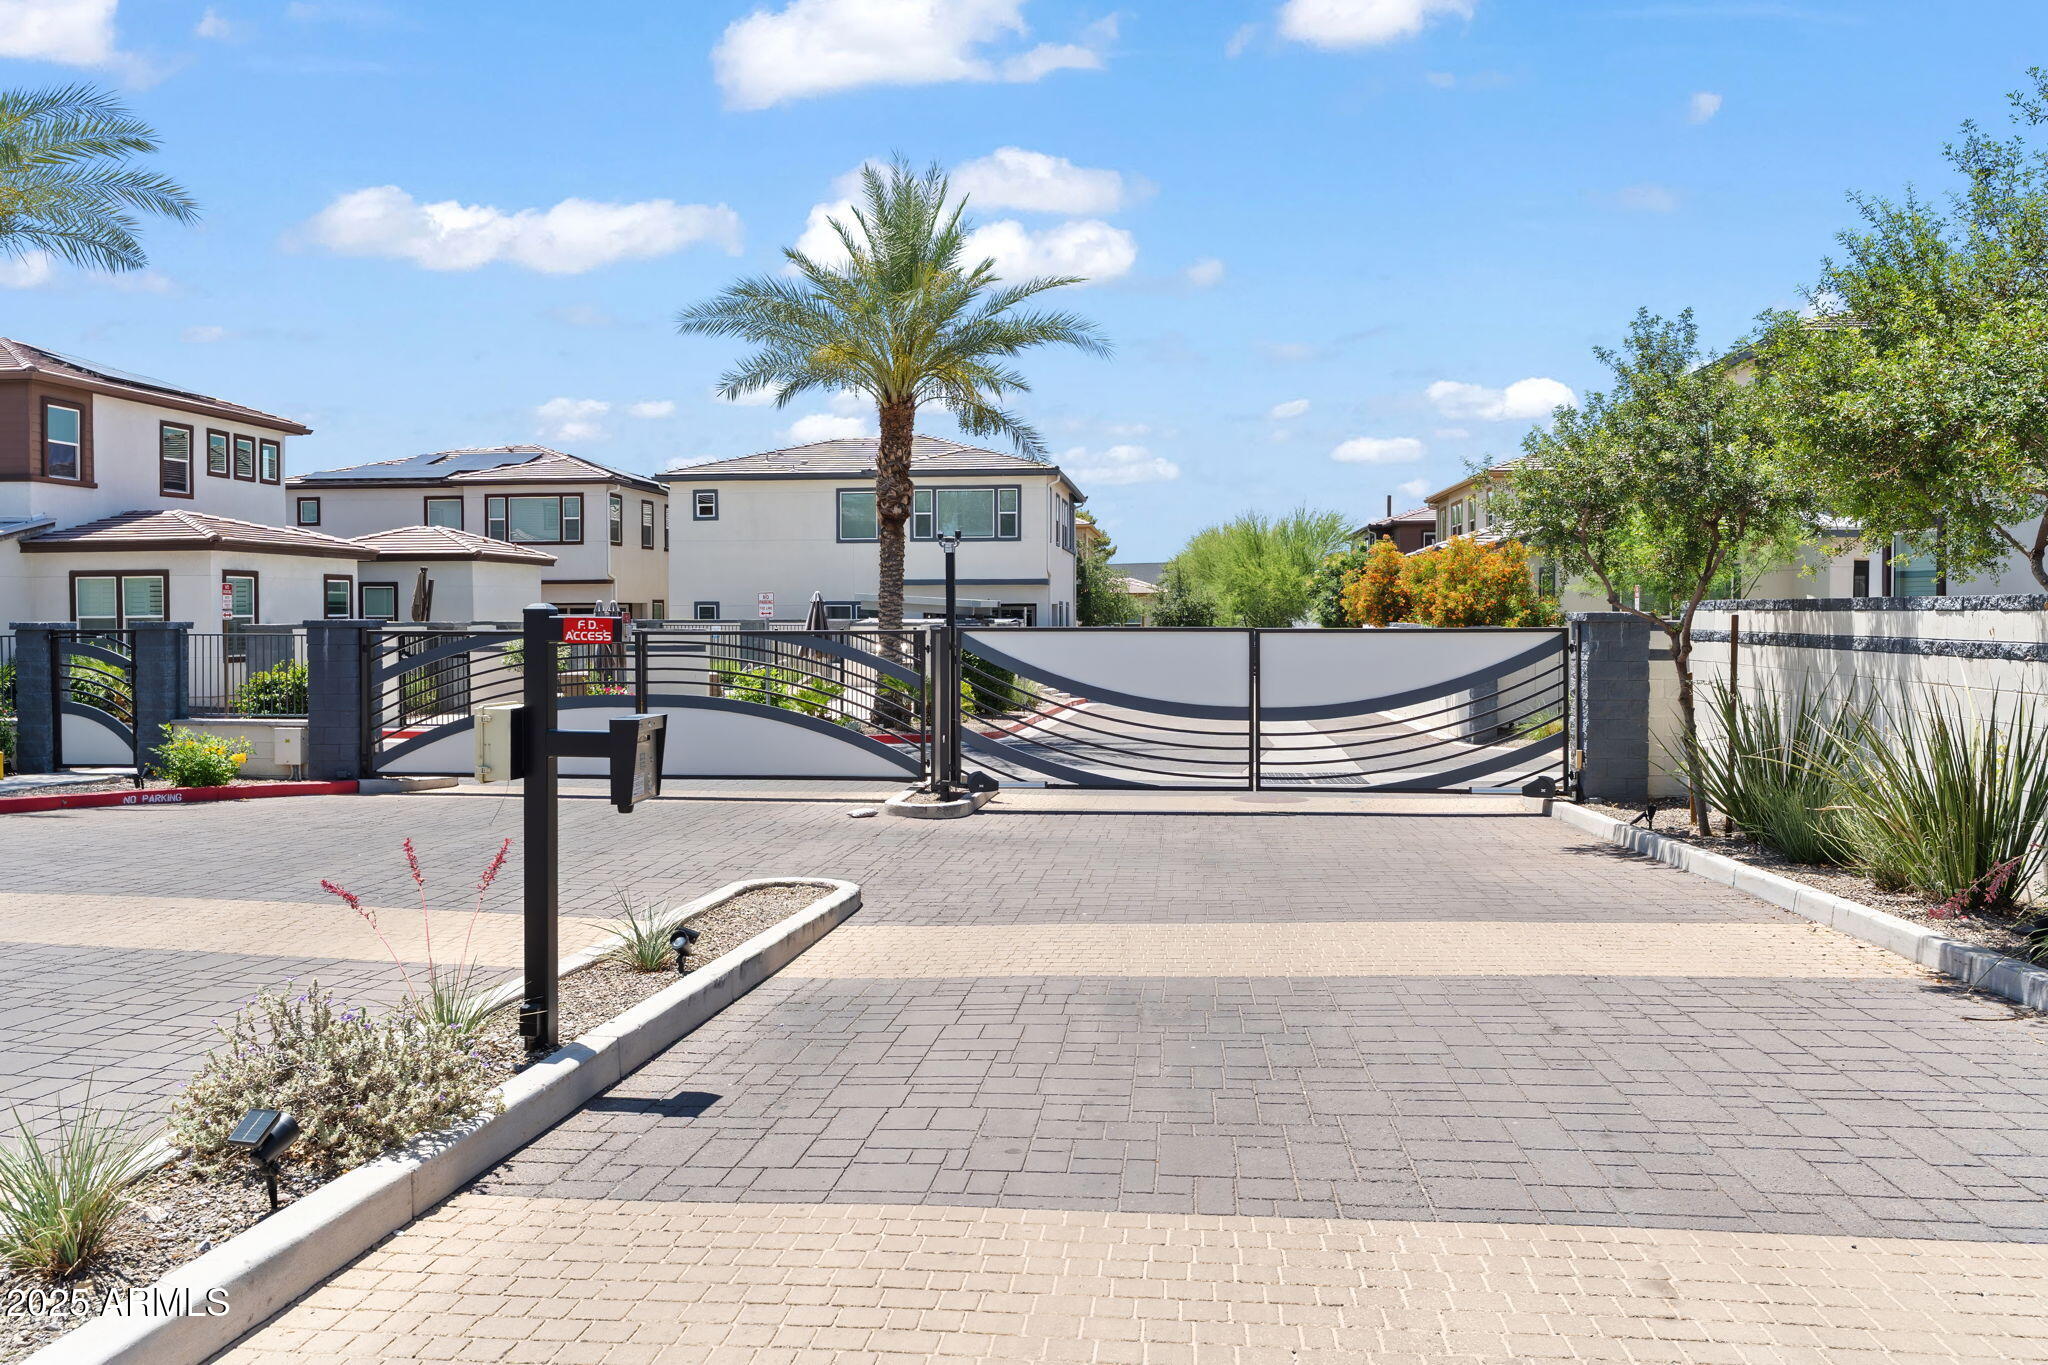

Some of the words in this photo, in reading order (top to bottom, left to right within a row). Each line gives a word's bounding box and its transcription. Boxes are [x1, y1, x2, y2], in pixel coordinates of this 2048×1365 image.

[565, 631, 612, 641] ACCESS
[123, 795, 137, 804] NO
[142, 793, 182, 803] PARKING
